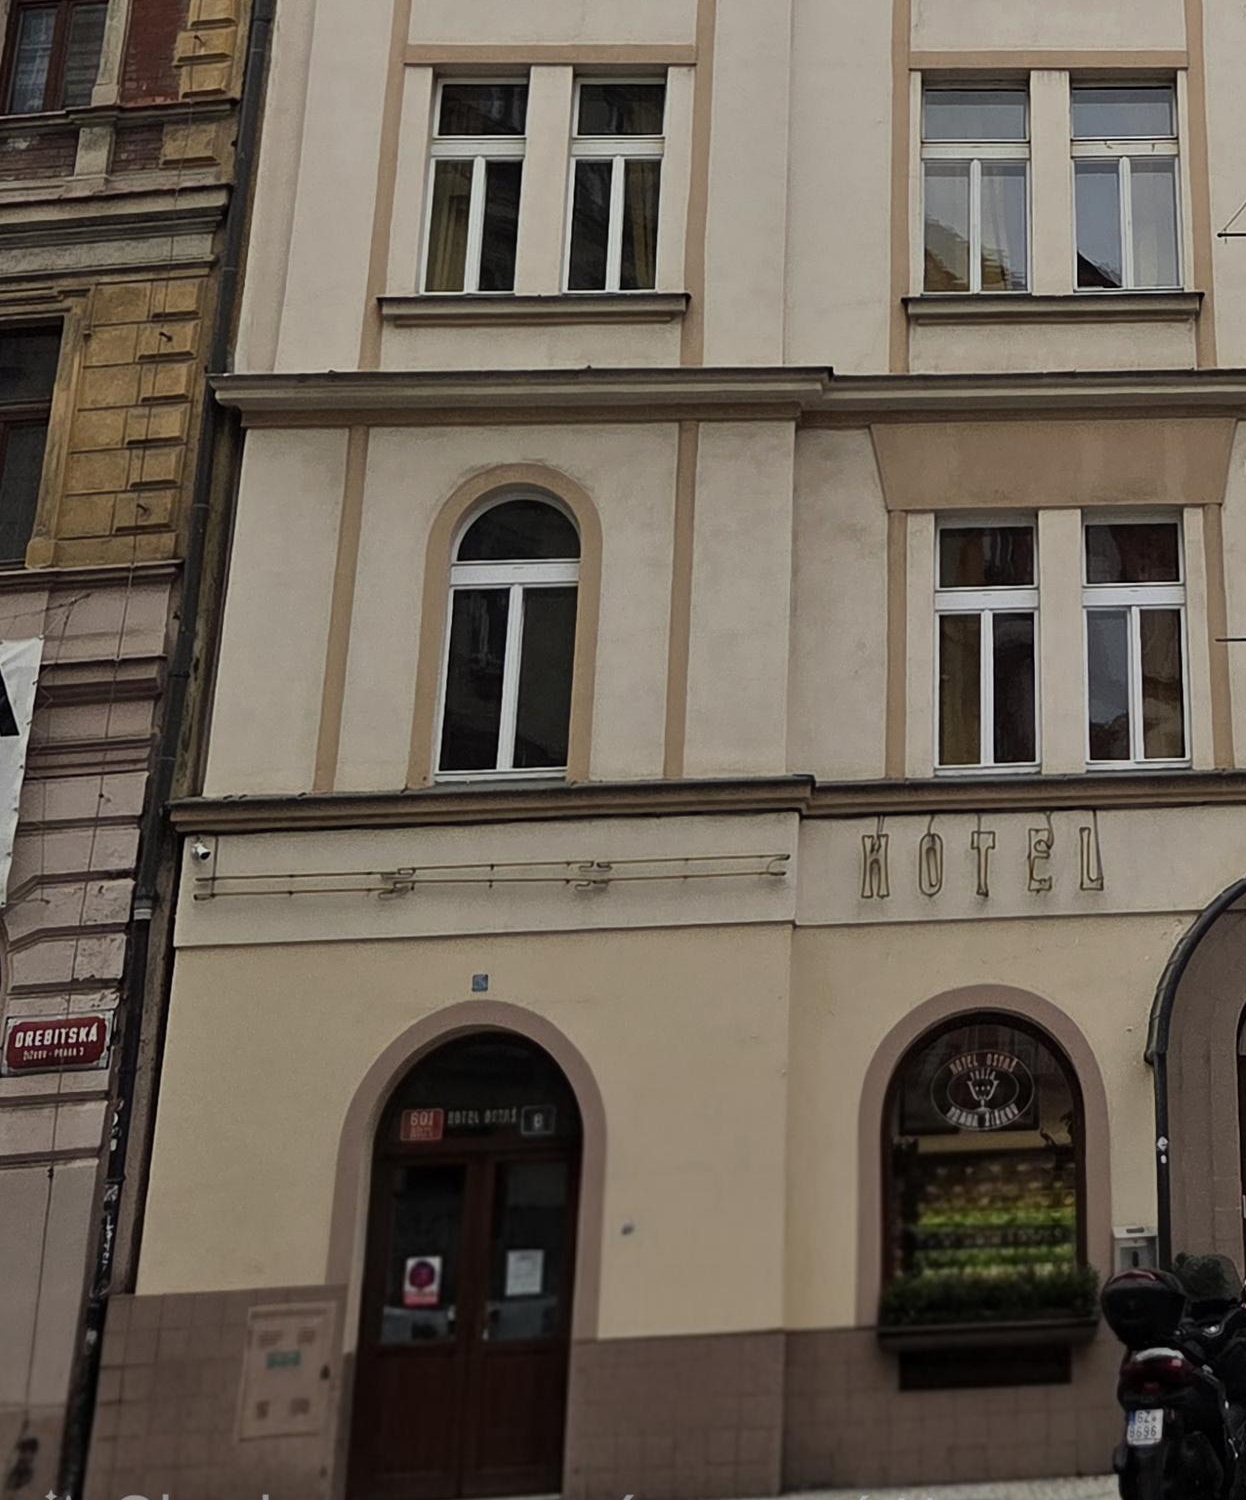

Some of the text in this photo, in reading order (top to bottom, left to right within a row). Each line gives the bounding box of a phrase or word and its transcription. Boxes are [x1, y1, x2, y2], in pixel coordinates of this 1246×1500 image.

[861, 827, 1104, 898] HOTEL
[14, 1022, 98, 1048] OREBITSKÁ
[79, 1046, 84, 1056] 3
[949, 1053, 978, 1075] HOTEL
[410, 1111, 434, 1126] 601
[448, 1110, 480, 1125] HOTEL
